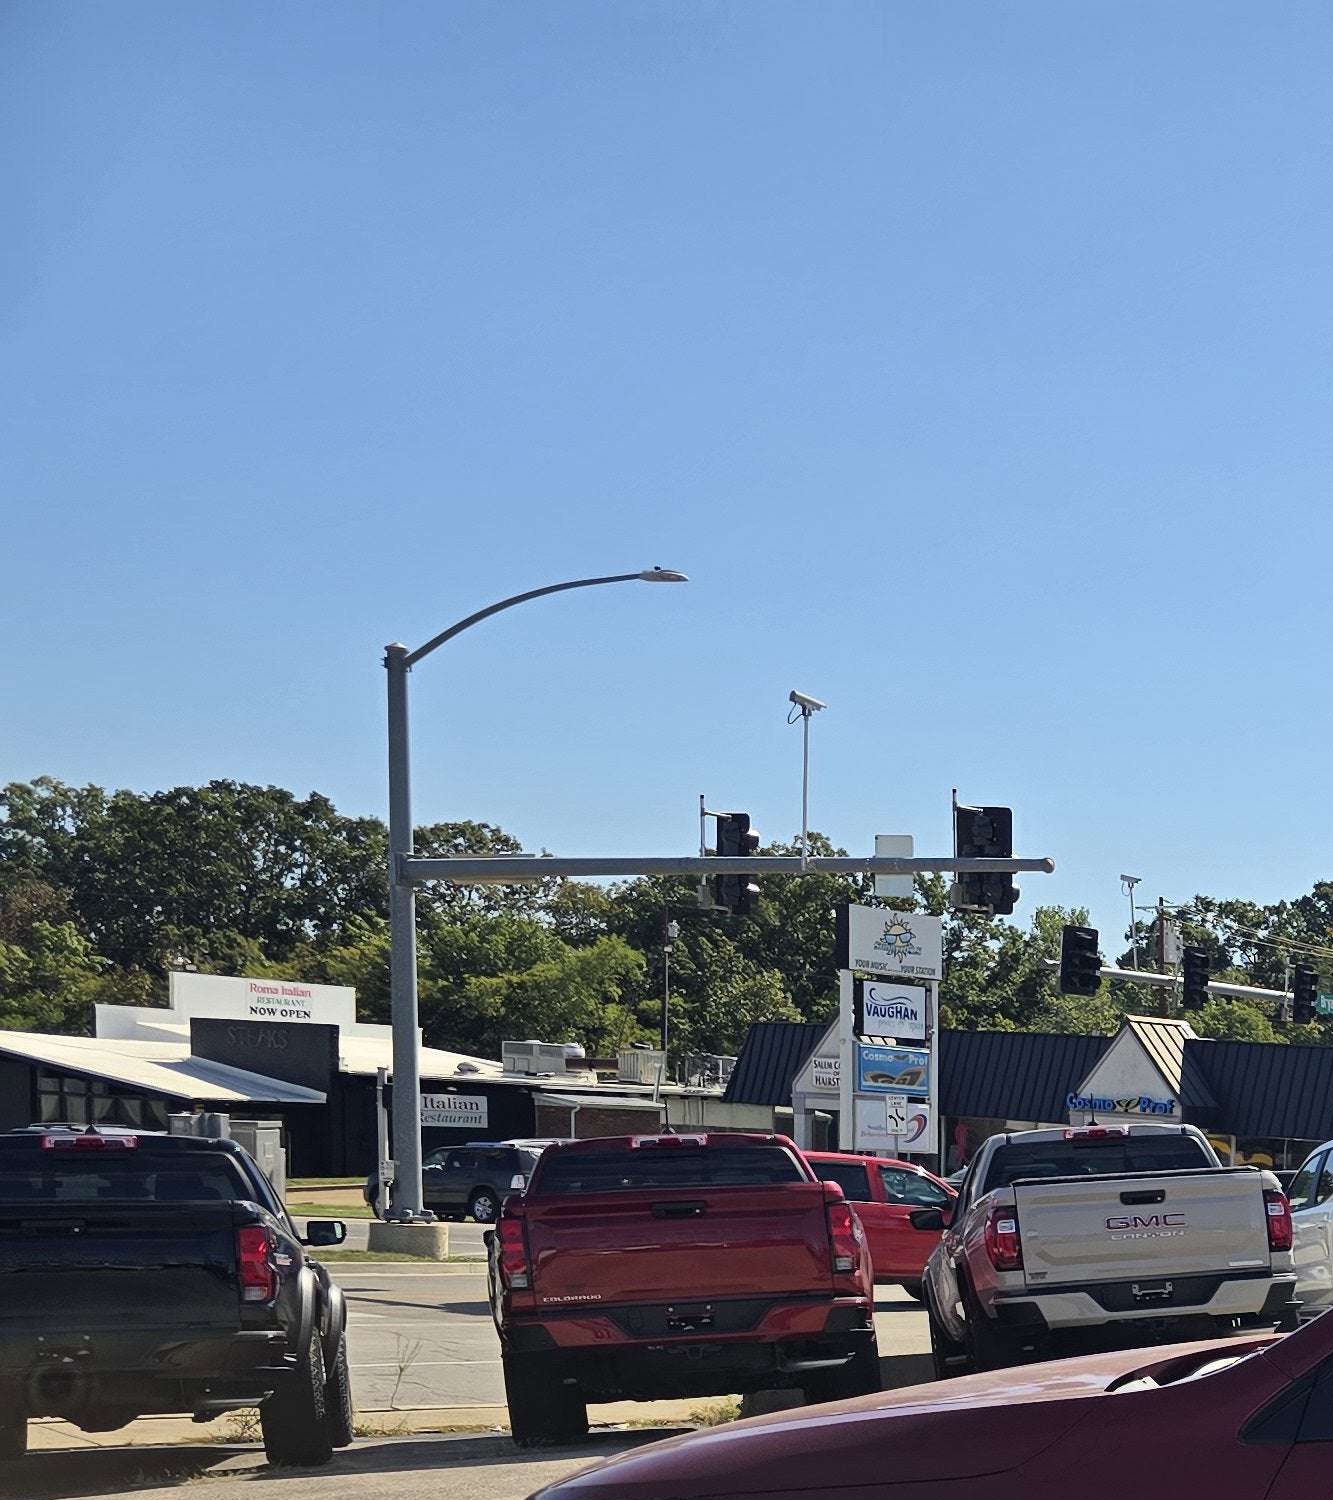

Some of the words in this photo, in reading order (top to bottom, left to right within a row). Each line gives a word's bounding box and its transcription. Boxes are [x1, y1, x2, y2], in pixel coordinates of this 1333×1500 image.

[249, 983, 279, 995] Roma
[281, 985, 312, 998] Italian
[256, 996, 306, 1007] RESTAURANT
[249, 1005, 278, 1017] NOW
[280, 1008, 311, 1019] OPEN
[865, 1003, 918, 1021] VAUGHAN
[862, 1050, 894, 1063] Cosmo
[908, 1054, 929, 1066] Prof
[423, 1095, 480, 1111] Italian
[1065, 1092, 1116, 1111] Cosmo
[1139, 1096, 1176, 1114] Prof
[1104, 1212, 1188, 1232] GMC
[1110, 1230, 1185, 1241] CANYON
[542, 1293, 602, 1303] COLORADO
